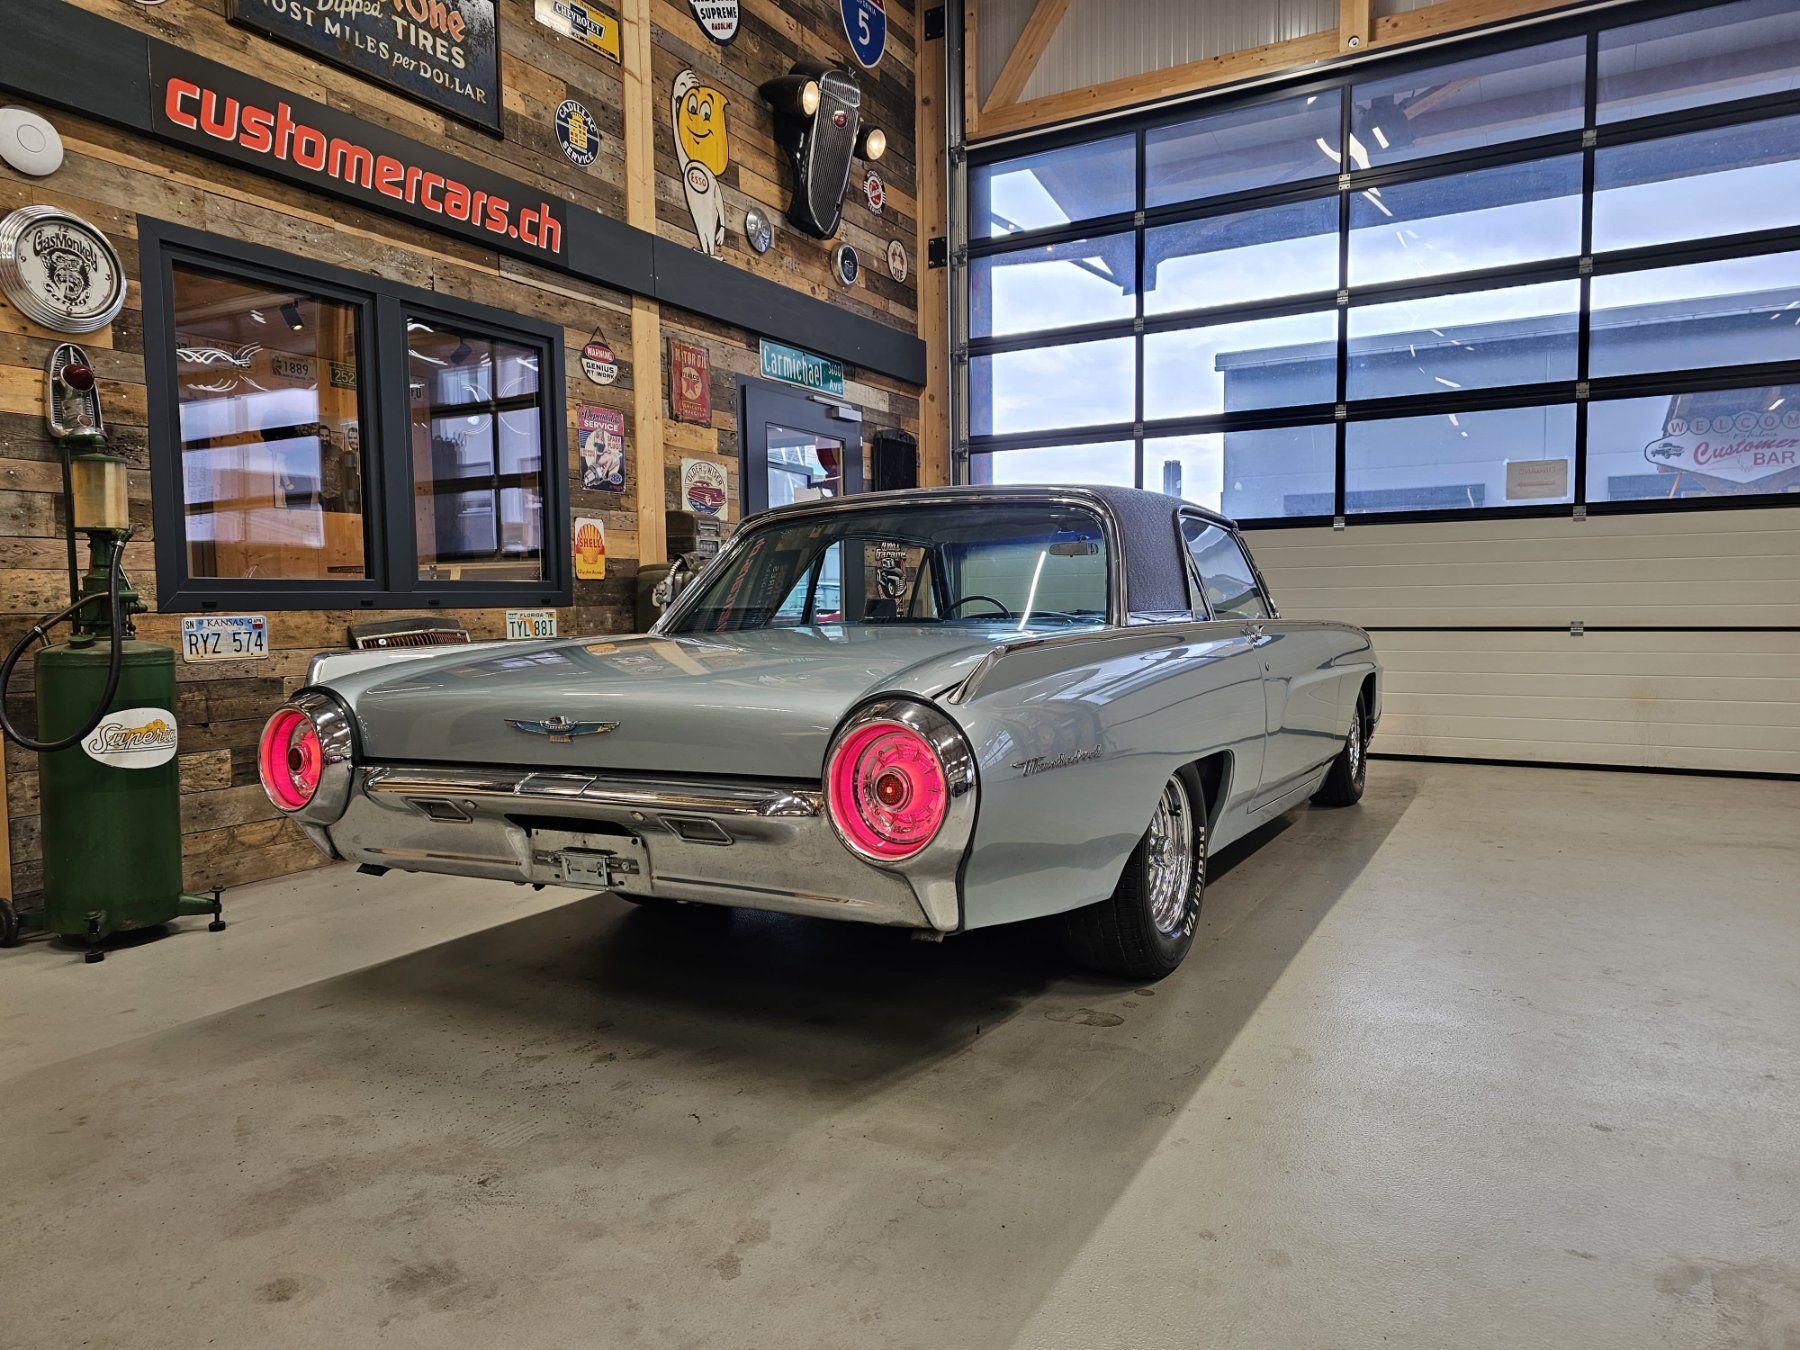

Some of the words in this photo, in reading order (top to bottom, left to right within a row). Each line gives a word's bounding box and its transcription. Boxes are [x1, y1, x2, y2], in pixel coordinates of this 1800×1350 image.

[555, 3, 601, 35] CHEVROLET
[700, 7, 738, 20] SUPREME
[858, 8, 870, 46] 5
[261, 0, 316, 27] OST
[324, 16, 390, 60] MILES
[392, 51, 418, 71] per
[419, 60, 488, 105] DOLLAR
[391, 14, 467, 70] TIRES
[558, 102, 597, 133] CADILLAC
[561, 140, 594, 164] SERVICE
[165, 77, 562, 253] customercars.ch
[283, 360, 309, 376] 1889
[586, 361, 615, 374] GENIUS
[596, 371, 615, 380] WORK
[763, 345, 823, 387] Carmichael
[829, 379, 843, 393] Ave
[584, 420, 619, 432] SERVICE
[1693, 438, 1800, 466] Customer
[1753, 450, 1796, 466] BAR
[579, 538, 602, 548] SHELL
[206, 618, 244, 627] KANSAS
[510, 620, 531, 638] TYL
[188, 632, 222, 655] RYZ
[232, 631, 264, 653] 574
